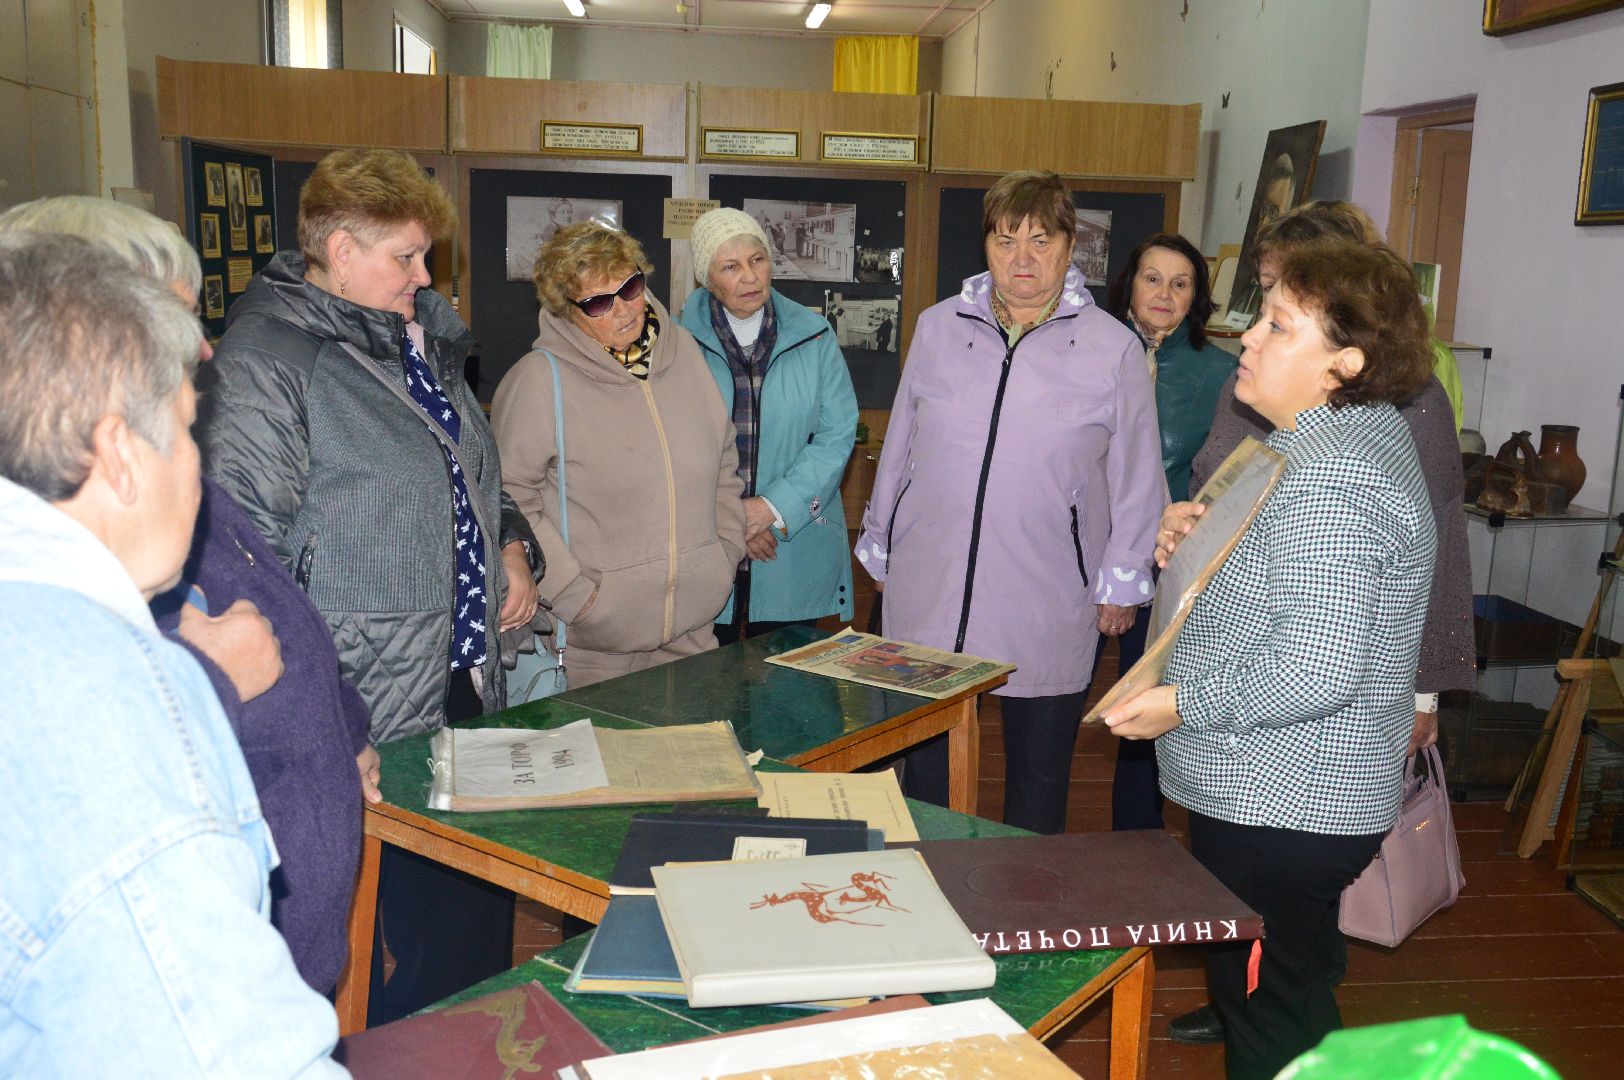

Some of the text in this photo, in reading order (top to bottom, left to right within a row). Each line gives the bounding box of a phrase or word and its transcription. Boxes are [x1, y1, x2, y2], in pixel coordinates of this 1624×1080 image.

[509, 743, 536, 784] ЗА ТОРФ
[551, 749, 575, 769] 1994
[972, 919, 1238, 952] КНИГА ПОЧЕТА
